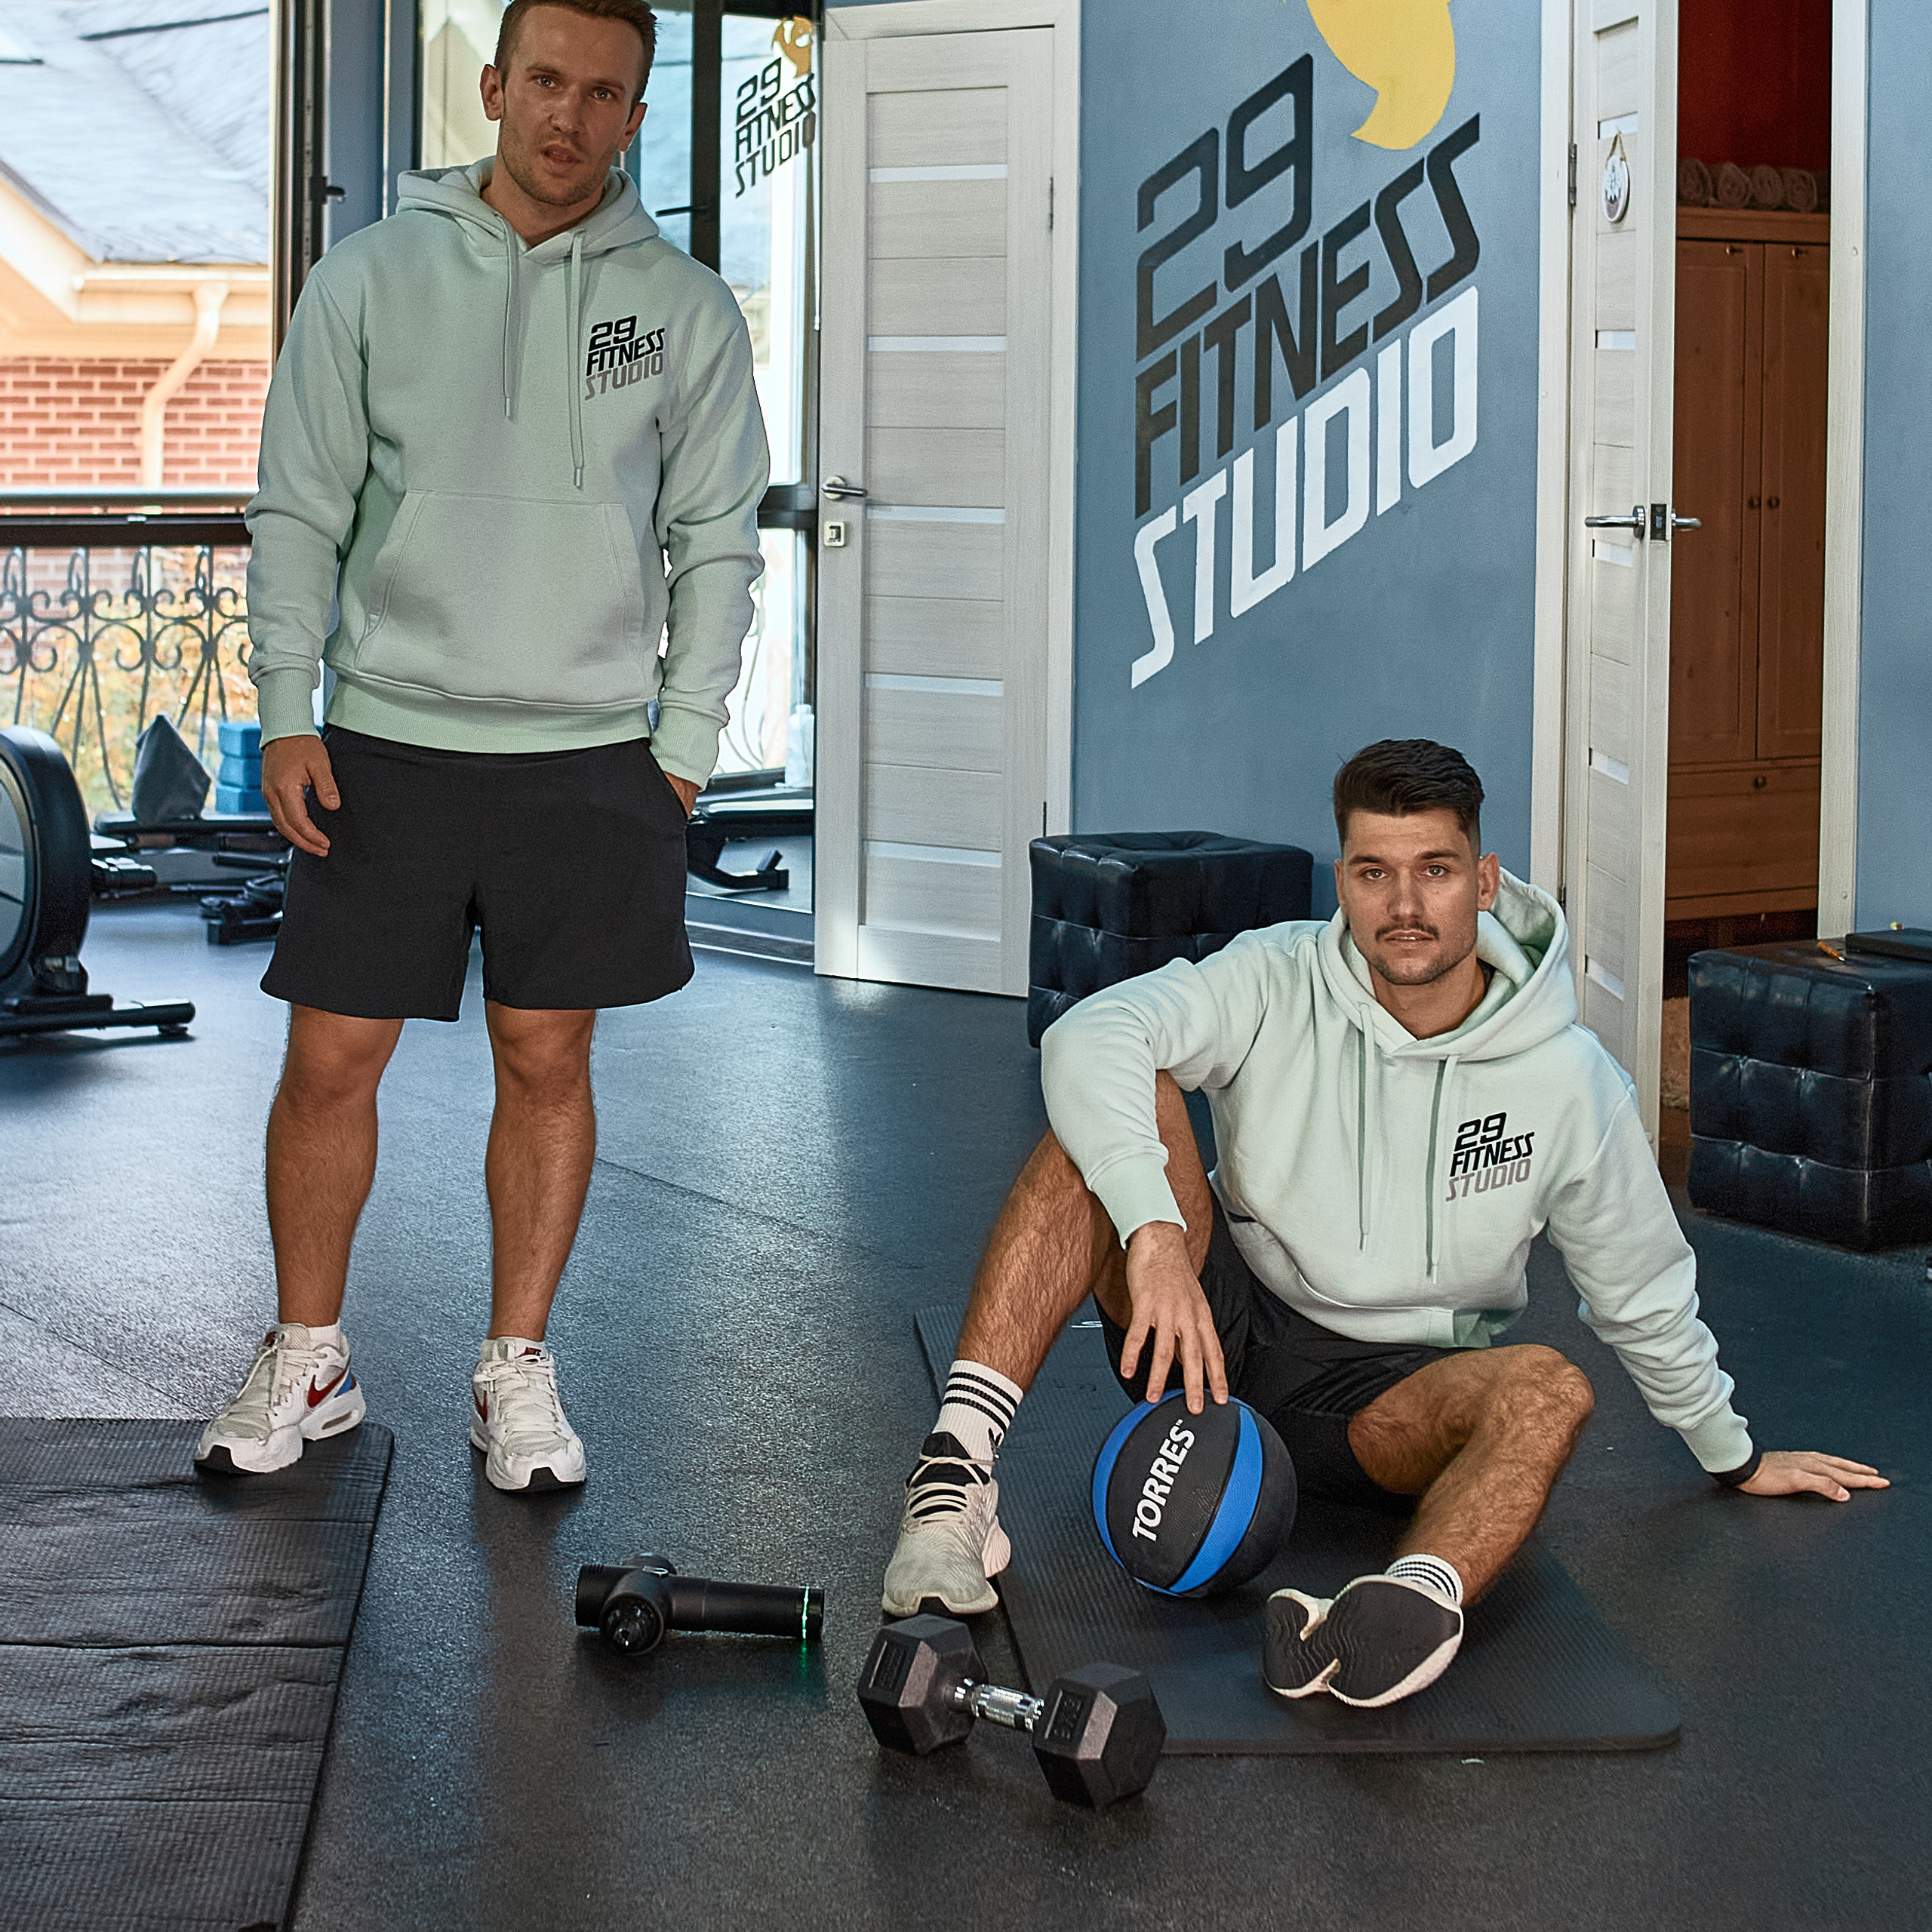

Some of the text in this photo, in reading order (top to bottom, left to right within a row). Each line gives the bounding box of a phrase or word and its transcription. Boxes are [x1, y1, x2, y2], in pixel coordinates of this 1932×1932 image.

[737, 57, 782, 127] 29
[1137, 53, 1312, 362] 29
[589, 315, 637, 352] 29
[1135, 112, 1480, 519] FITNESS
[584, 352, 663, 401] STUDIO
[586, 328, 665, 377] FITNESS
[1131, 285, 1478, 690] STUDIO
[1450, 1131, 1535, 1177] FITNESS
[1454, 1112, 1507, 1152] 29
[1445, 1158, 1531, 1201] STUDIO
[1132, 1425, 1195, 1542] TORRES
